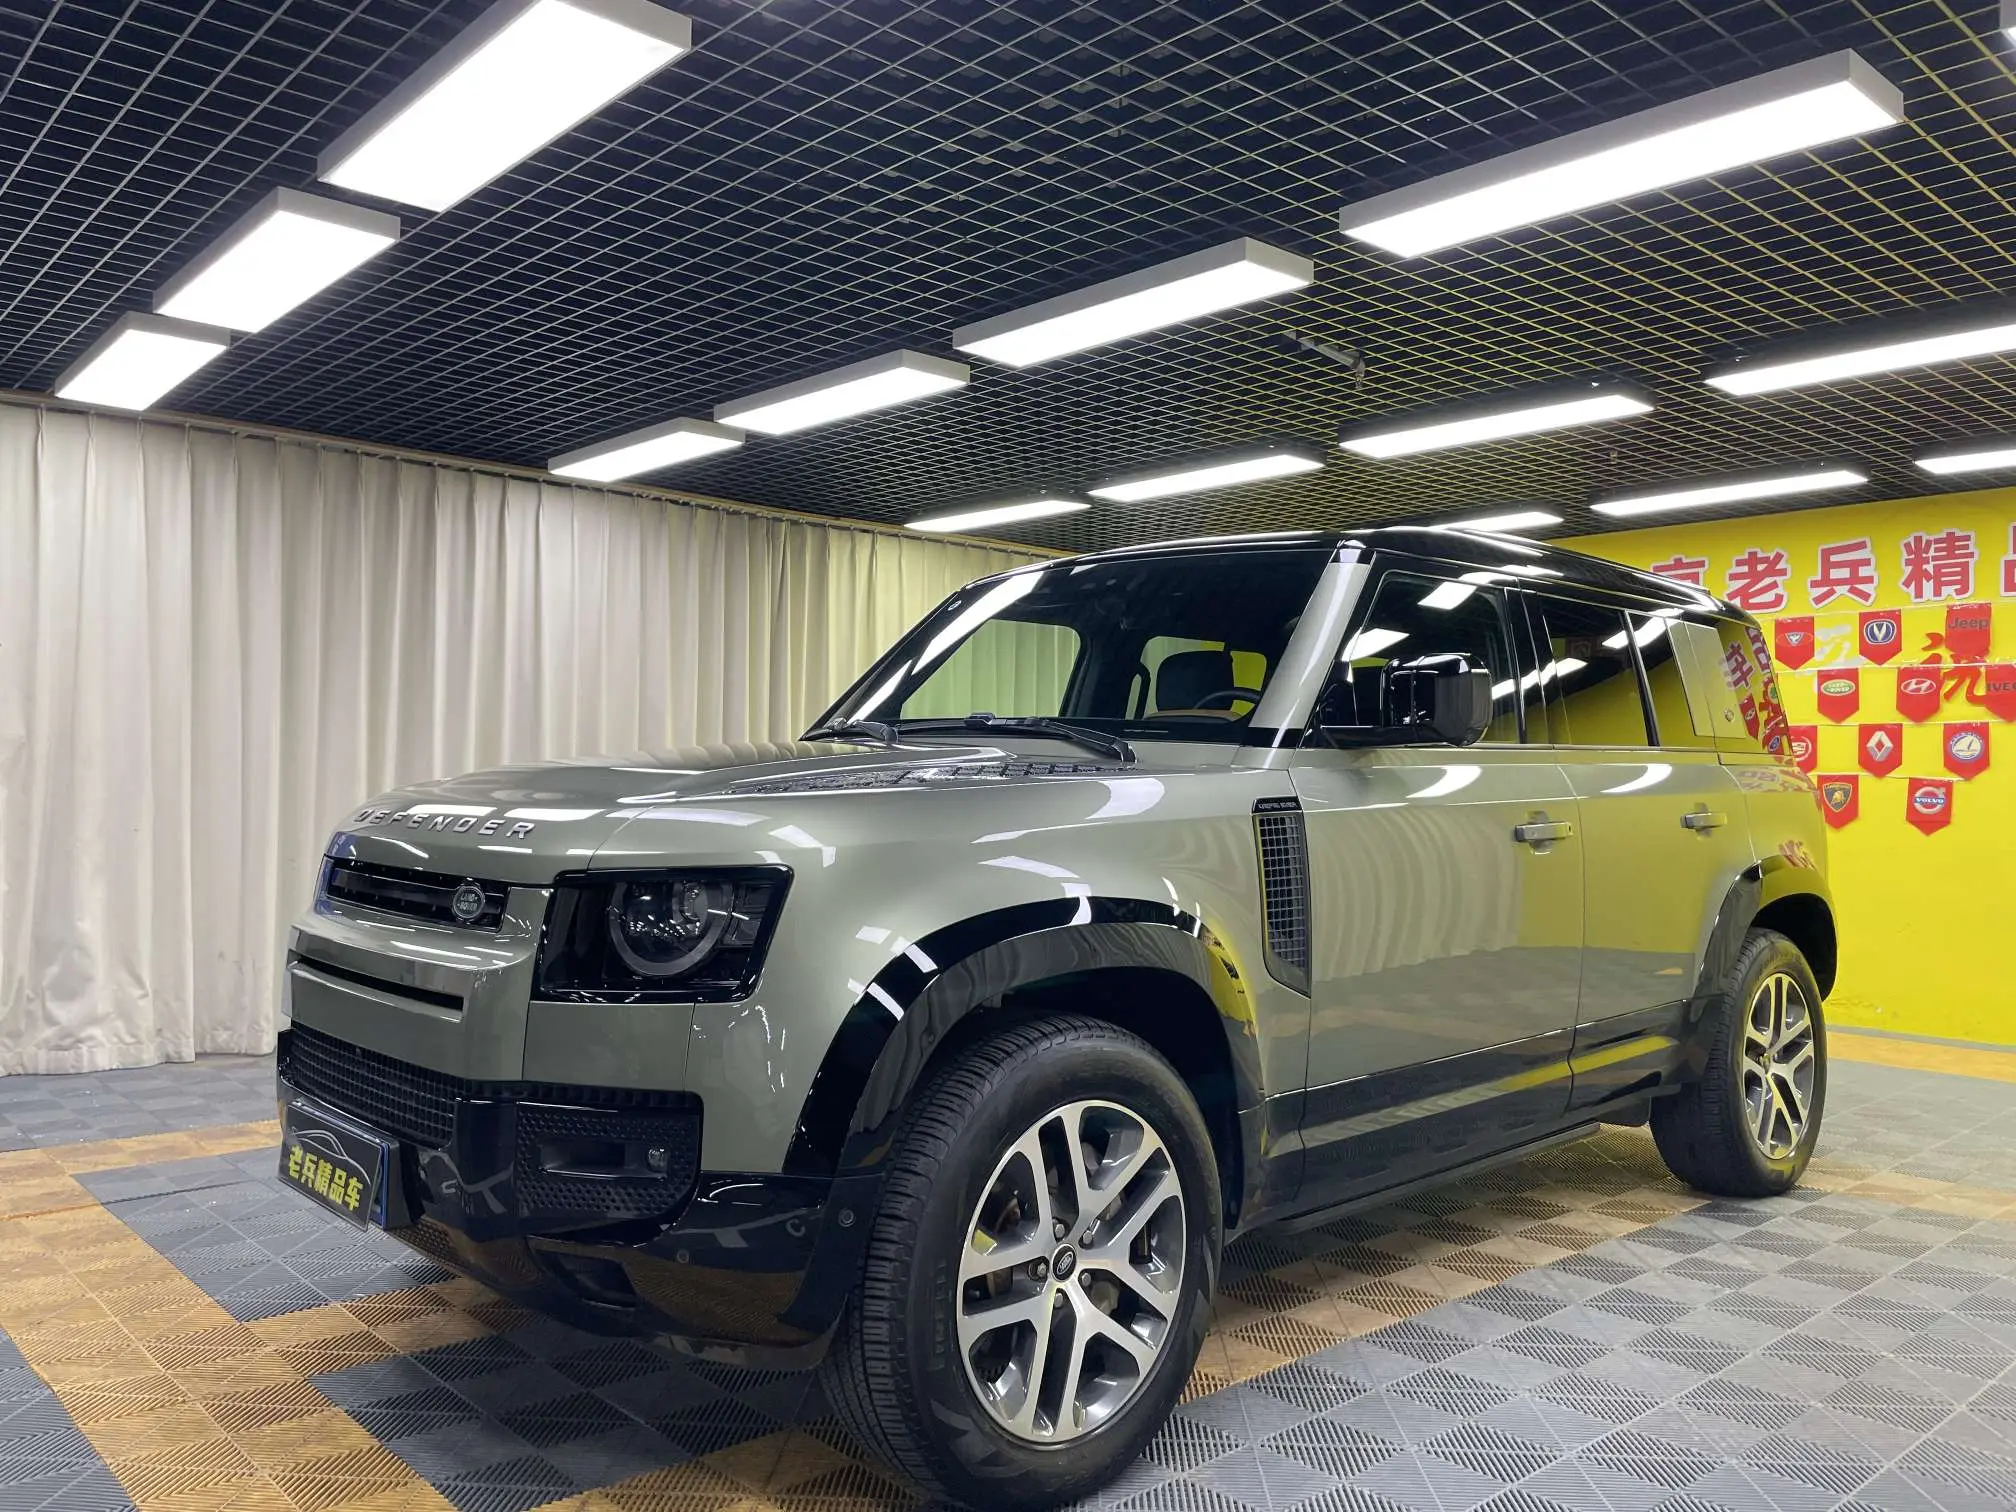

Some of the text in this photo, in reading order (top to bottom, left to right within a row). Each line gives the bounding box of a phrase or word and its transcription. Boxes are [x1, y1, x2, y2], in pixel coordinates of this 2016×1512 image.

[1651, 524, 2016, 613] 老兵精
[1948, 617, 1989, 630] Jeep
[354, 807, 536, 839] DEFENDER
[288, 1144, 364, 1211] 老兵精品车
